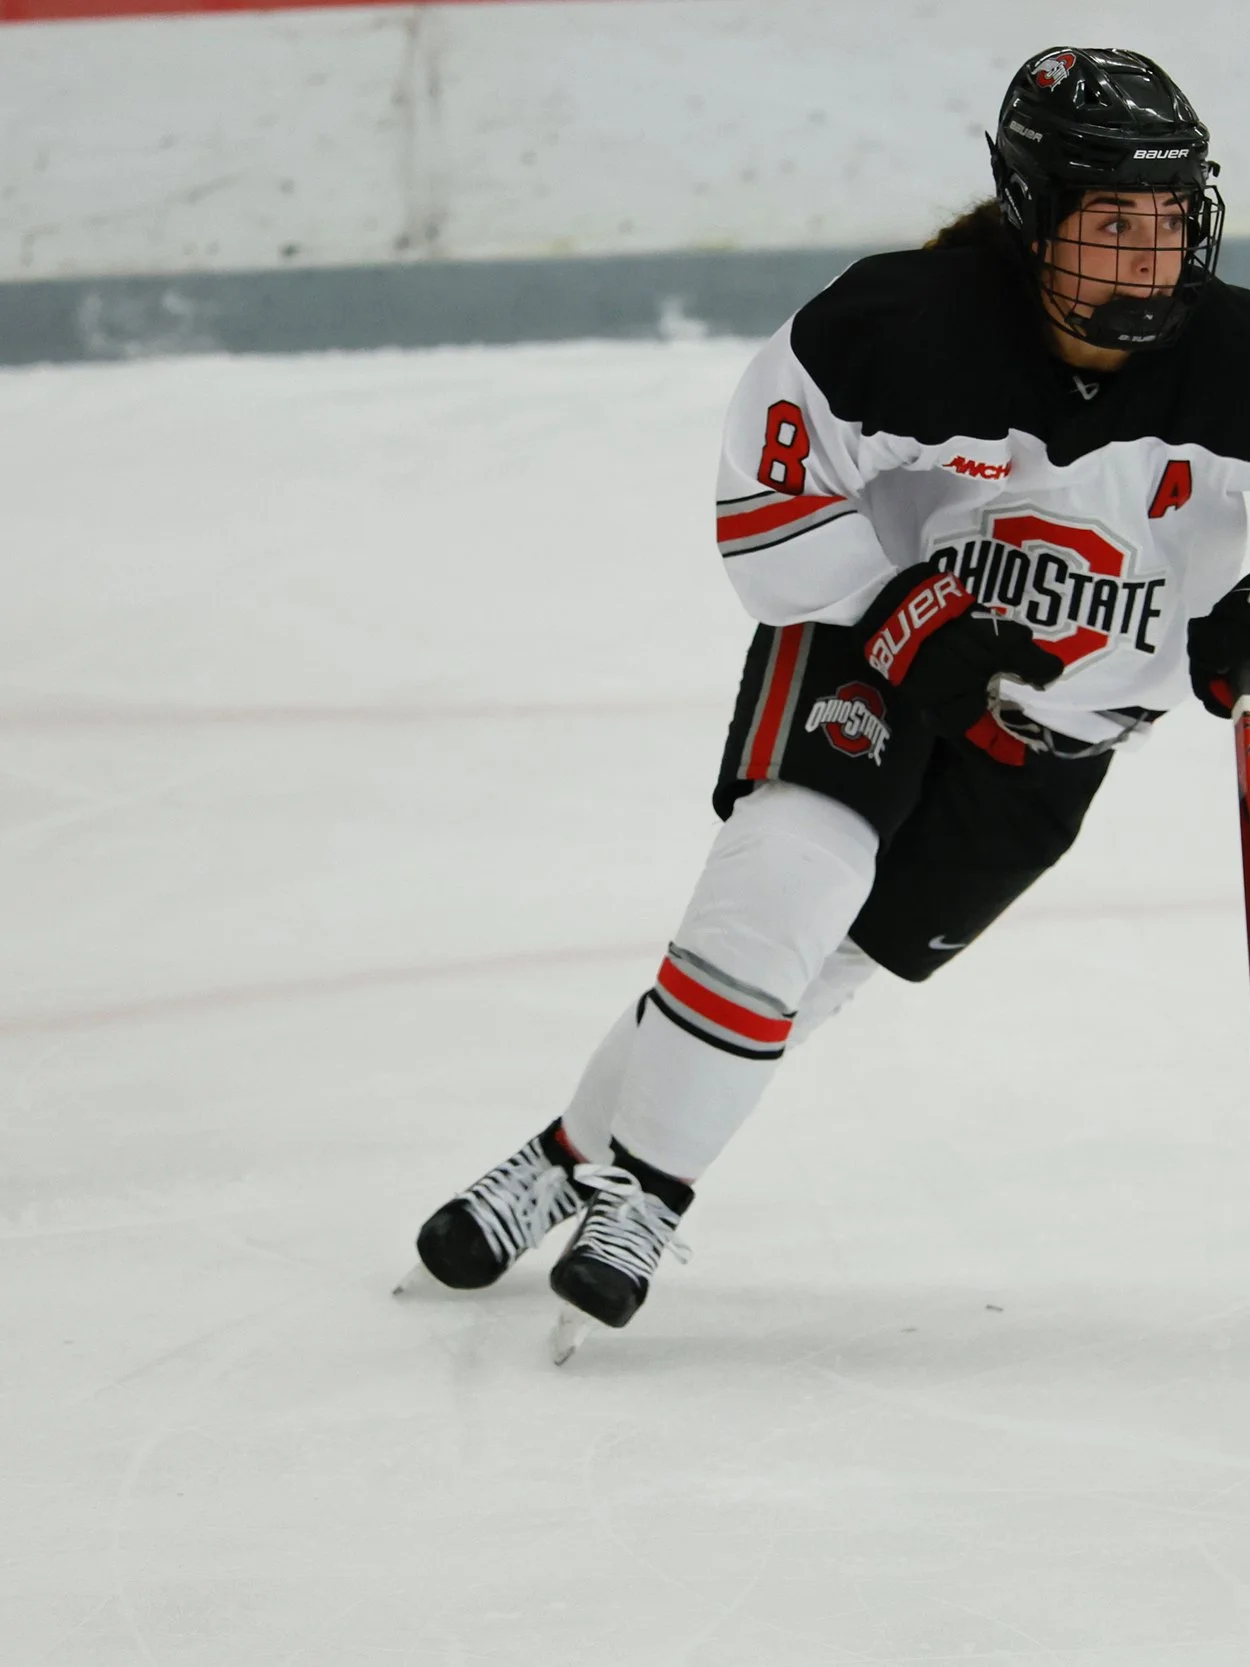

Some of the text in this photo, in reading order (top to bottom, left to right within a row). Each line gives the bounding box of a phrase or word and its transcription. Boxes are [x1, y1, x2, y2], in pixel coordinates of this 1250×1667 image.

[1133, 149, 1189, 159] BAUER
[757, 400, 810, 495] 8
[1148, 459, 1192, 519] A
[1026, 552, 1166, 654] STATE
[804, 699, 890, 767] OHIO STATE
